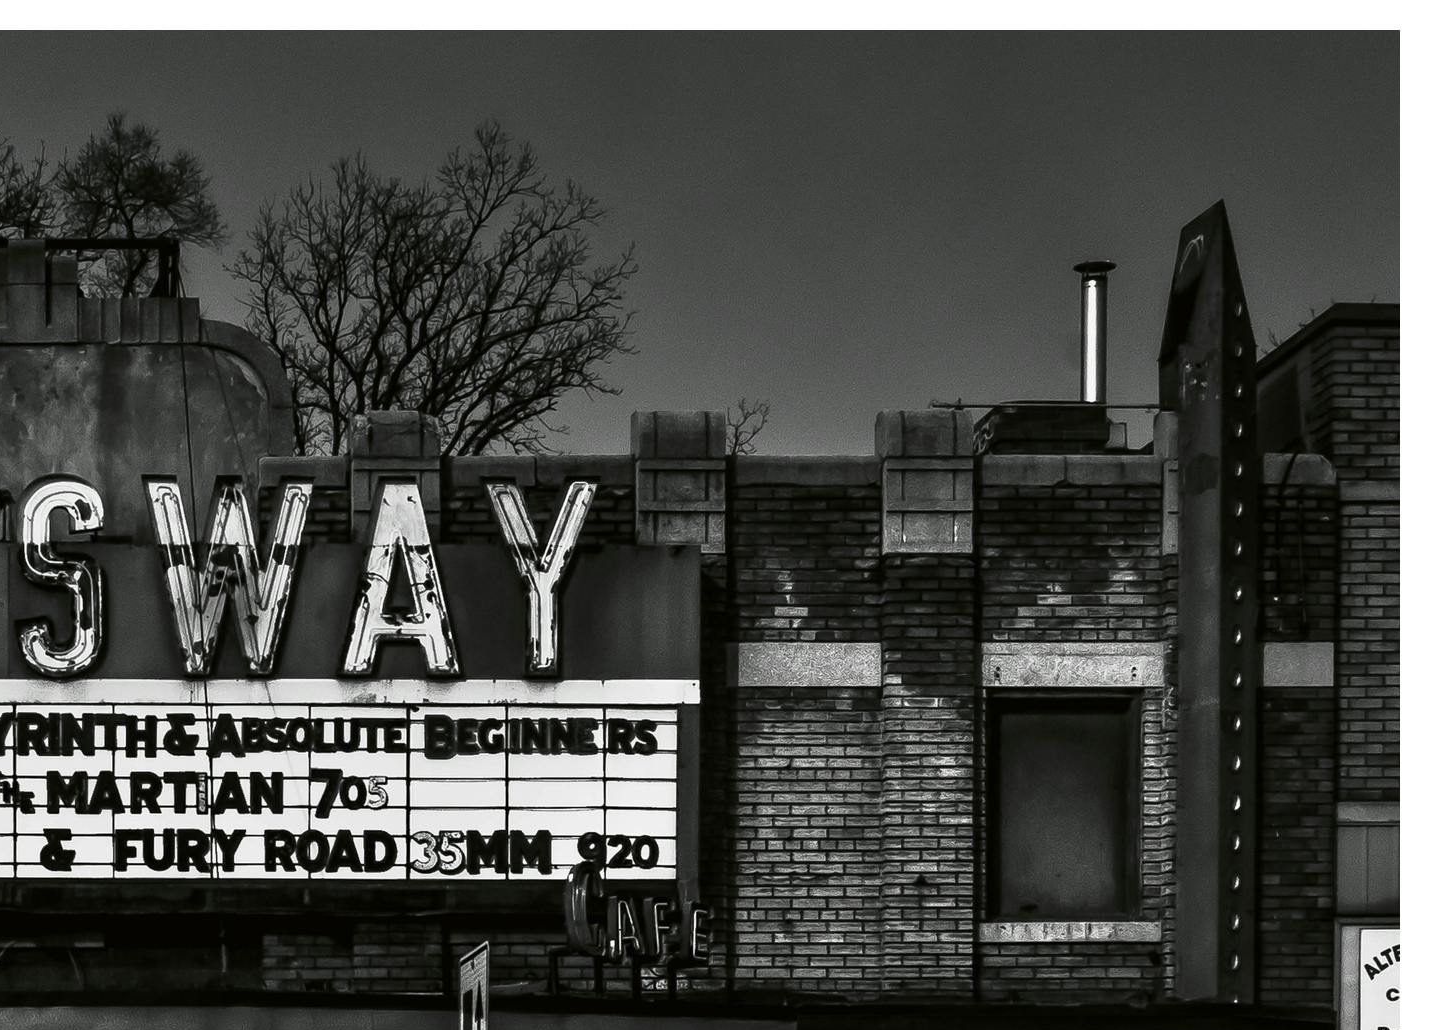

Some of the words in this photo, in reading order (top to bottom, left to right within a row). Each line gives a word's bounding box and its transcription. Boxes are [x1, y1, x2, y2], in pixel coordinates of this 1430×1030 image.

[208, 714, 407, 758] ABSOLUTE
[425, 714, 657, 759] BEGINNERS
[46, 771, 283, 814] MARTIAN
[311, 769, 388, 818] 705
[40, 829, 76, 872] &
[114, 829, 246, 872] FURY
[264, 829, 397, 872] ROAD
[411, 829, 552, 874] 35MM
[577, 832, 659, 869] 920
